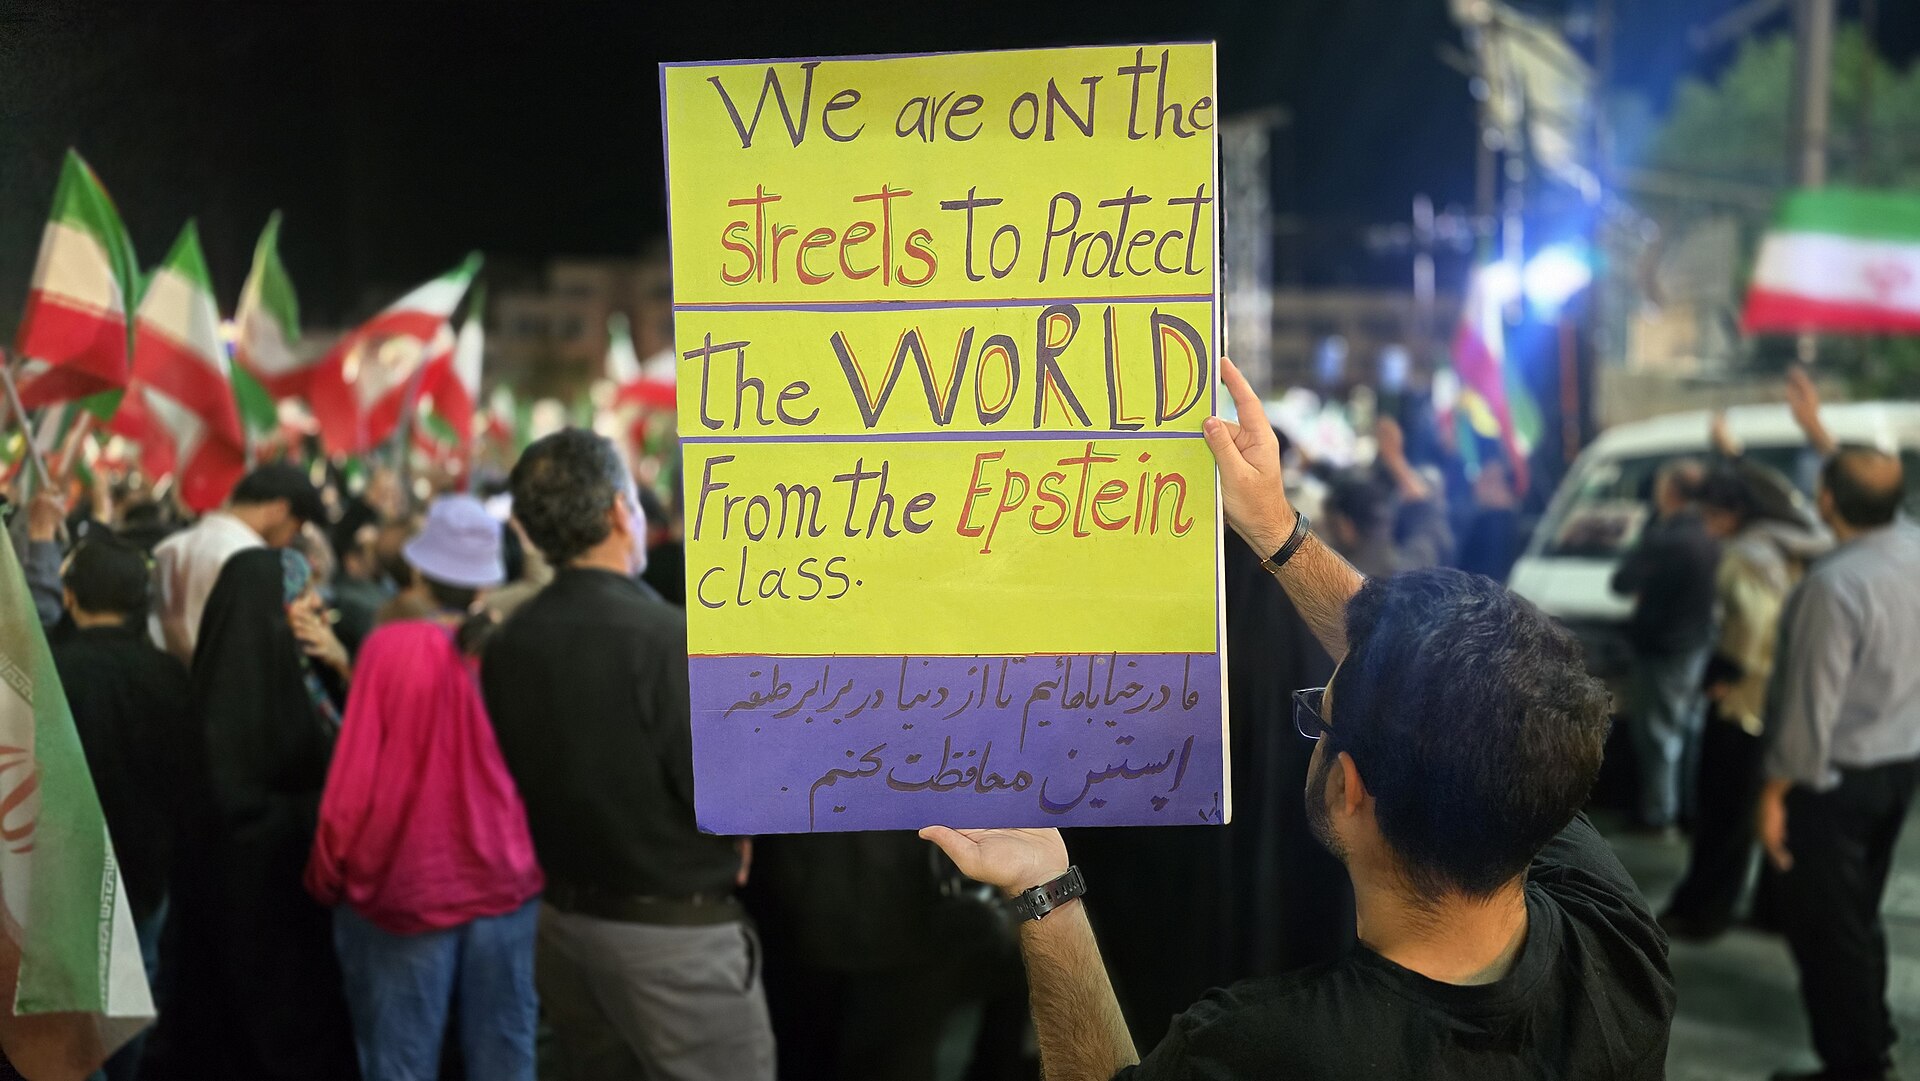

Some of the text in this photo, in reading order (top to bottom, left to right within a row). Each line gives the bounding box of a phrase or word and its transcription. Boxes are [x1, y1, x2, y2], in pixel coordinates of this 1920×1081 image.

[706, 62, 866, 149] We
[895, 90, 984, 143] are
[1117, 47, 1214, 141] the
[719, 181, 1212, 287] streets to Protect
[683, 304, 1209, 431] the WORLD
[693, 441, 1196, 555] From the Epstein
[697, 545, 863, 609] class.
[723, 663, 792, 733] طبقه
[772, 663, 854, 725] برابر
[844, 688, 885, 719] در
[897, 655, 949, 731] دنیا
[942, 663, 990, 721] از
[995, 656, 1027, 710] تا
[1123, 683, 1171, 715] در
[1181, 653, 1200, 711] ما
[886, 735, 1034, 794] محافظت
[1039, 734, 1195, 815] اپستین
